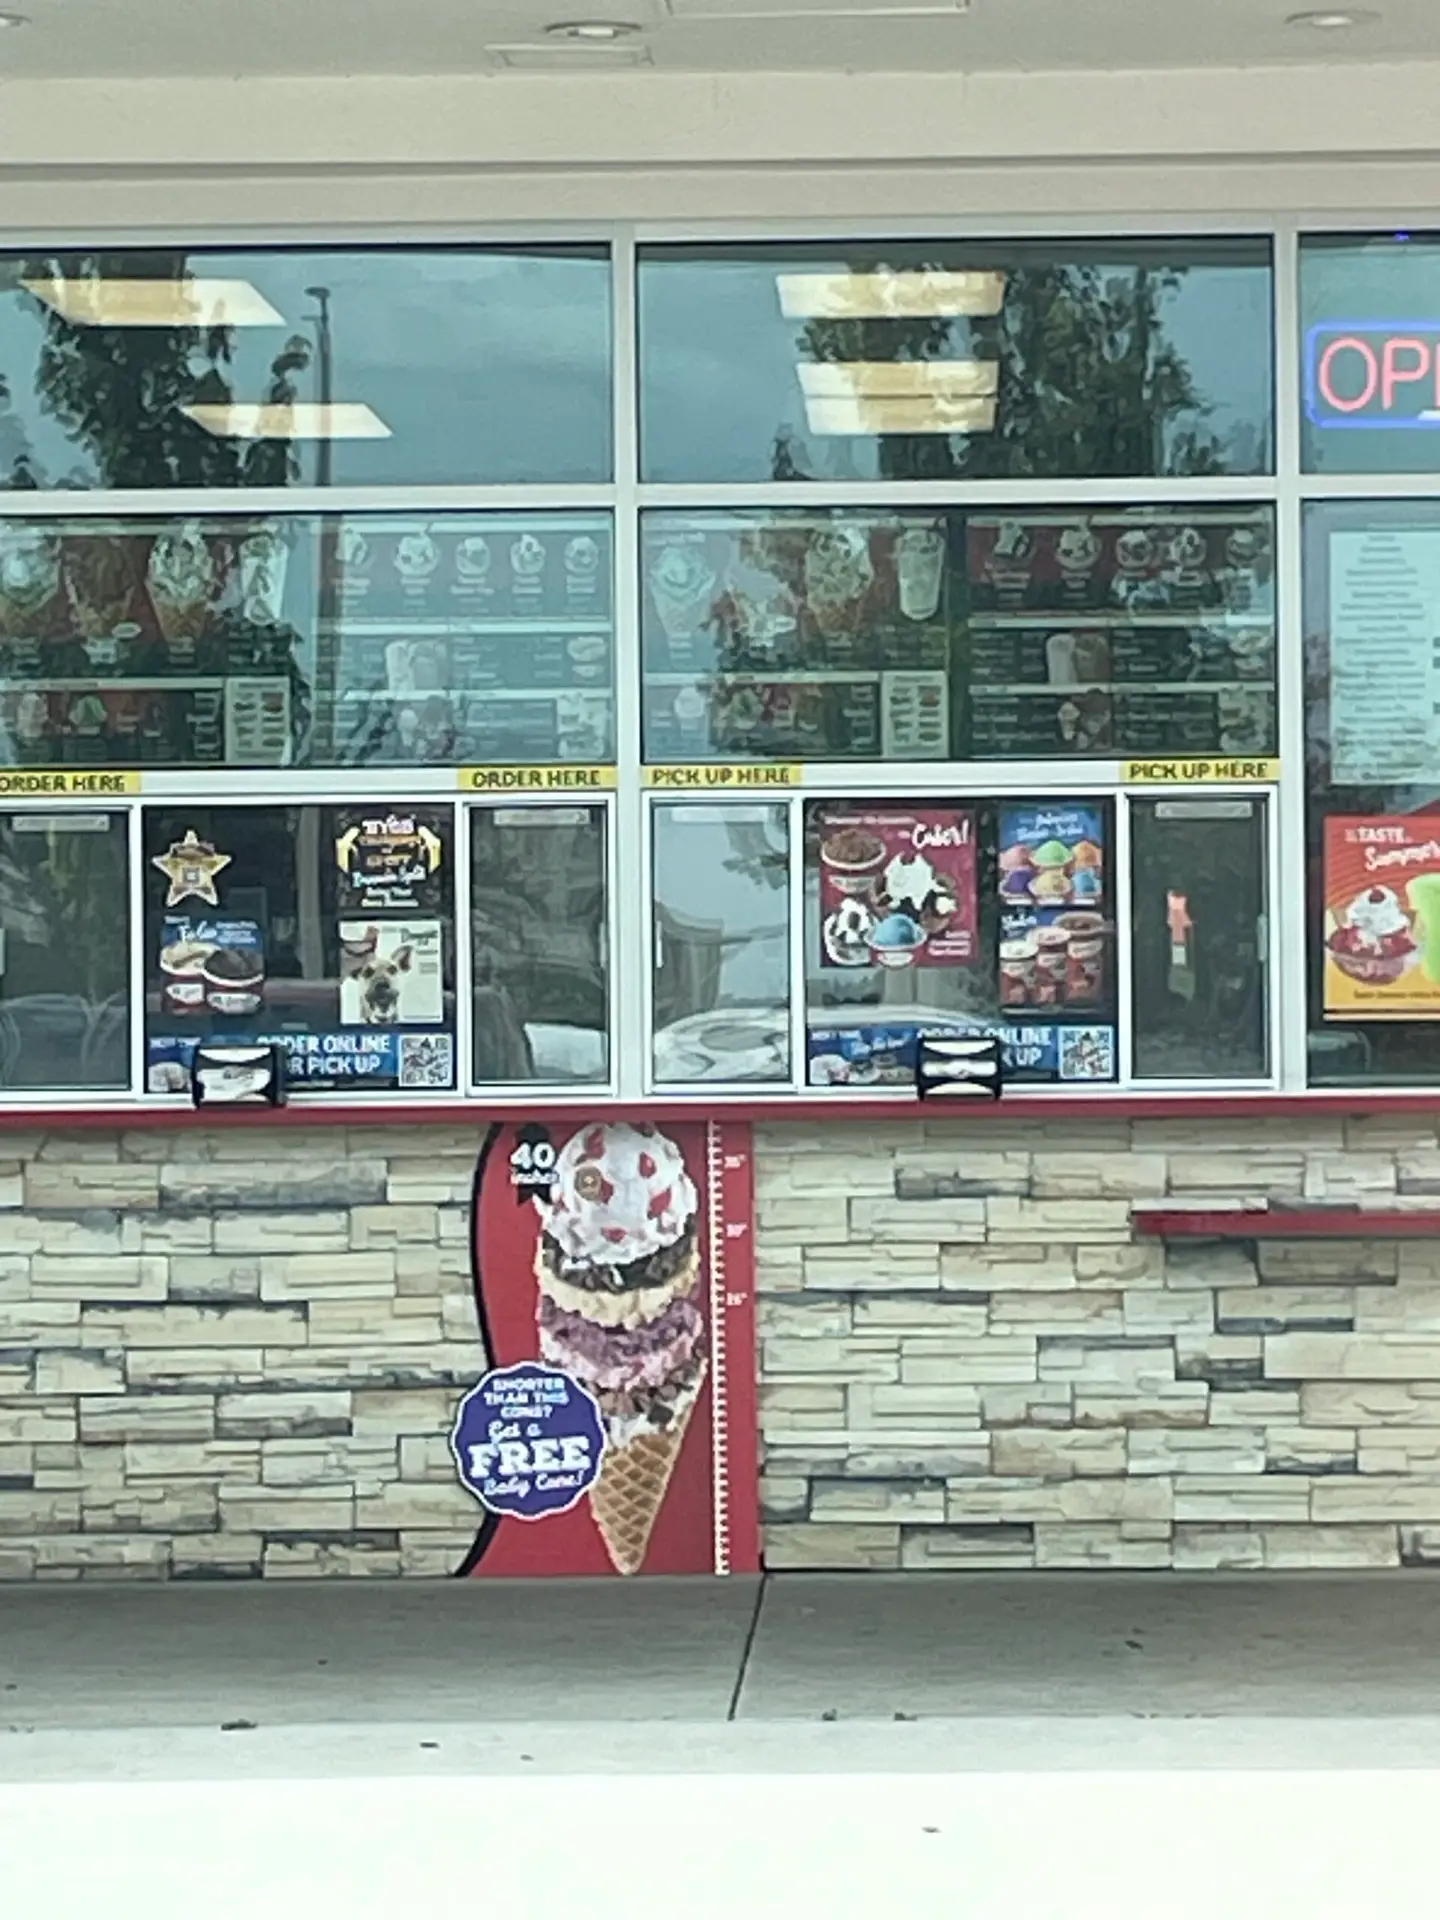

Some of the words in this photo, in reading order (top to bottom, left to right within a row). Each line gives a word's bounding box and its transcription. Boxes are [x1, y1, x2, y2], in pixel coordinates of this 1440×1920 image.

[1319, 337, 1440, 412] OP
[473, 770, 542, 788] ORDER
[548, 770, 599, 786] HERE
[653, 768, 699, 784] PICK
[705, 768, 732, 784] UP
[737, 768, 788, 784] HERE
[1130, 763, 1177, 779] PICK
[1182, 763, 1211, 778] UP
[1215, 762, 1267, 778] HERE
[0, 775, 66, 792] ORDER
[73, 774, 125, 792] HERE
[323, 1034, 390, 1053] ONLINE
[307, 1056, 352, 1075] PICK
[355, 1054, 381, 1073] UP
[1016, 1046, 1042, 1066] UP
[510, 1142, 556, 1169] 40
[493, 1378, 565, 1391] SHORTER
[484, 1392, 529, 1405] THAN
[533, 1391, 569, 1405] THIS
[469, 1436, 591, 1478] FREE
[484, 1476, 531, 1498] Baby
